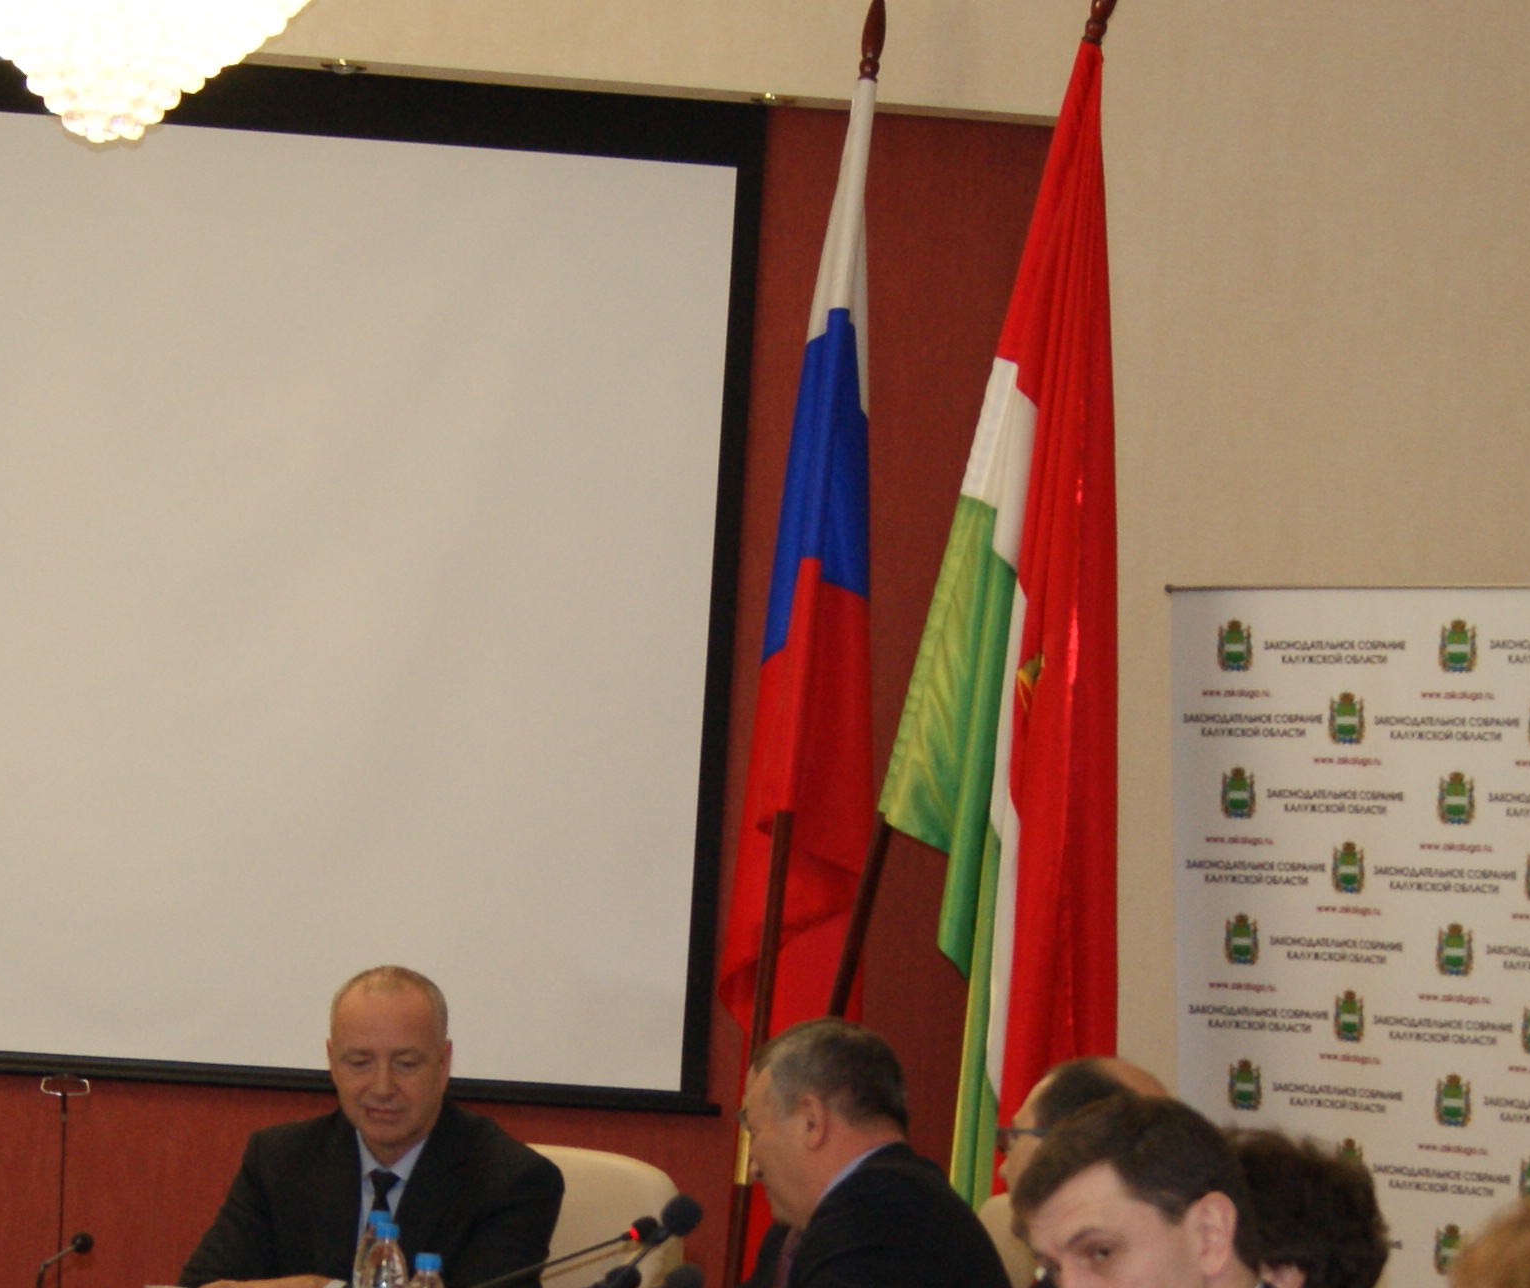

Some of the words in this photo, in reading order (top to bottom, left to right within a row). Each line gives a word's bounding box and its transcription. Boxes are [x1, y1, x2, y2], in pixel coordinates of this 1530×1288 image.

[1263, 640, 1356, 651] ЗАКОНОДАТЕЛЬНОЕ
[1357, 640, 1406, 651] СОБРАНИЕ
[1281, 653, 1343, 665] КАЛУЖСКОЙ
[1345, 654, 1388, 665] ОБЛАСТИ
[1183, 713, 1273, 724] ЗАКОНОДАТЕЛЬНОЕ
[1274, 713, 1323, 724] СОБРАНИЕ
[1374, 715, 1466, 728] ЗАКОНОДАТЕЛЬНОЕ
[1468, 717, 1520, 728] СОБРАНИЕ
[1201, 727, 1261, 738] КАЛУЖСКОЙ
[1263, 728, 1306, 738] ОБЛАСТИ
[1390, 730, 1454, 741] КАЛУЖСКОЙ
[1455, 731, 1501, 742] ОБЛАСТИ
[1267, 789, 1357, 801] ЗАКОНОДАТЕЛЬНОЕ
[1360, 790, 1404, 802] СОБРАНИЕ
[1283, 803, 1346, 814] КАЛУЖСКОЙ
[1348, 804, 1387, 815] ОБЛАСТИ
[1185, 860, 1275, 872] ЗАКОНОДАТЕЛЬНОЕ
[1277, 861, 1326, 873] СОБРАНИЕ
[1373, 865, 1464, 878] ЗАКОНОДАТЕЛЬНОЕ
[1467, 869, 1517, 880] СОБРАНИЕ
[1204, 873, 1264, 885] КАЛУЖСКОЙ
[1266, 875, 1309, 886] ОБЛАСТИ
[1389, 881, 1452, 892] КАЛУЖСКОЙ
[1454, 882, 1499, 894] ОБЛАСТИ
[1269, 936, 1357, 949] ЗАКОНОДАТЕЛЬНОЕ
[1359, 939, 1403, 952] СОБРАНИЕ
[1286, 951, 1346, 963] КАЛУЖСКОЙ
[1348, 953, 1387, 964] ОБЛАСТИ
[1188, 1005, 1278, 1018] ЗАКОНОДАТЕЛЬНОЕ
[1280, 1008, 1329, 1020] СОБРАНИЕ
[1207, 1020, 1267, 1032] КАЛУЖСКОЙ
[1269, 1022, 1311, 1033] ОБЛАСТИ
[1373, 1014, 1463, 1029] ЗАКОНОДАТЕЛЬНОЕ
[1465, 1020, 1513, 1033] СОБРАНИЕ
[1388, 1031, 1451, 1043] КАЛУЖСКОЙ
[1452, 1033, 1497, 1046] ОБЛАСТИ
[1272, 1082, 1358, 1098] ЗАКОНОДАТЕЛЬНОЕ
[1360, 1087, 1403, 1101] СОБРАНИЕ
[1289, 1097, 1348, 1110] КАЛУЖСКОЙ
[1348, 1101, 1386, 1114] ОБЛАСТИ
[1373, 1164, 1460, 1181] ЗАКОНОДАТЕЛЬНОЕ
[1461, 1167, 1511, 1185] СОБРАНИЕ
[1388, 1179, 1448, 1193] КАЛУЖСКОЙ
[1449, 1182, 1494, 1197] ОБЛАСТИ
